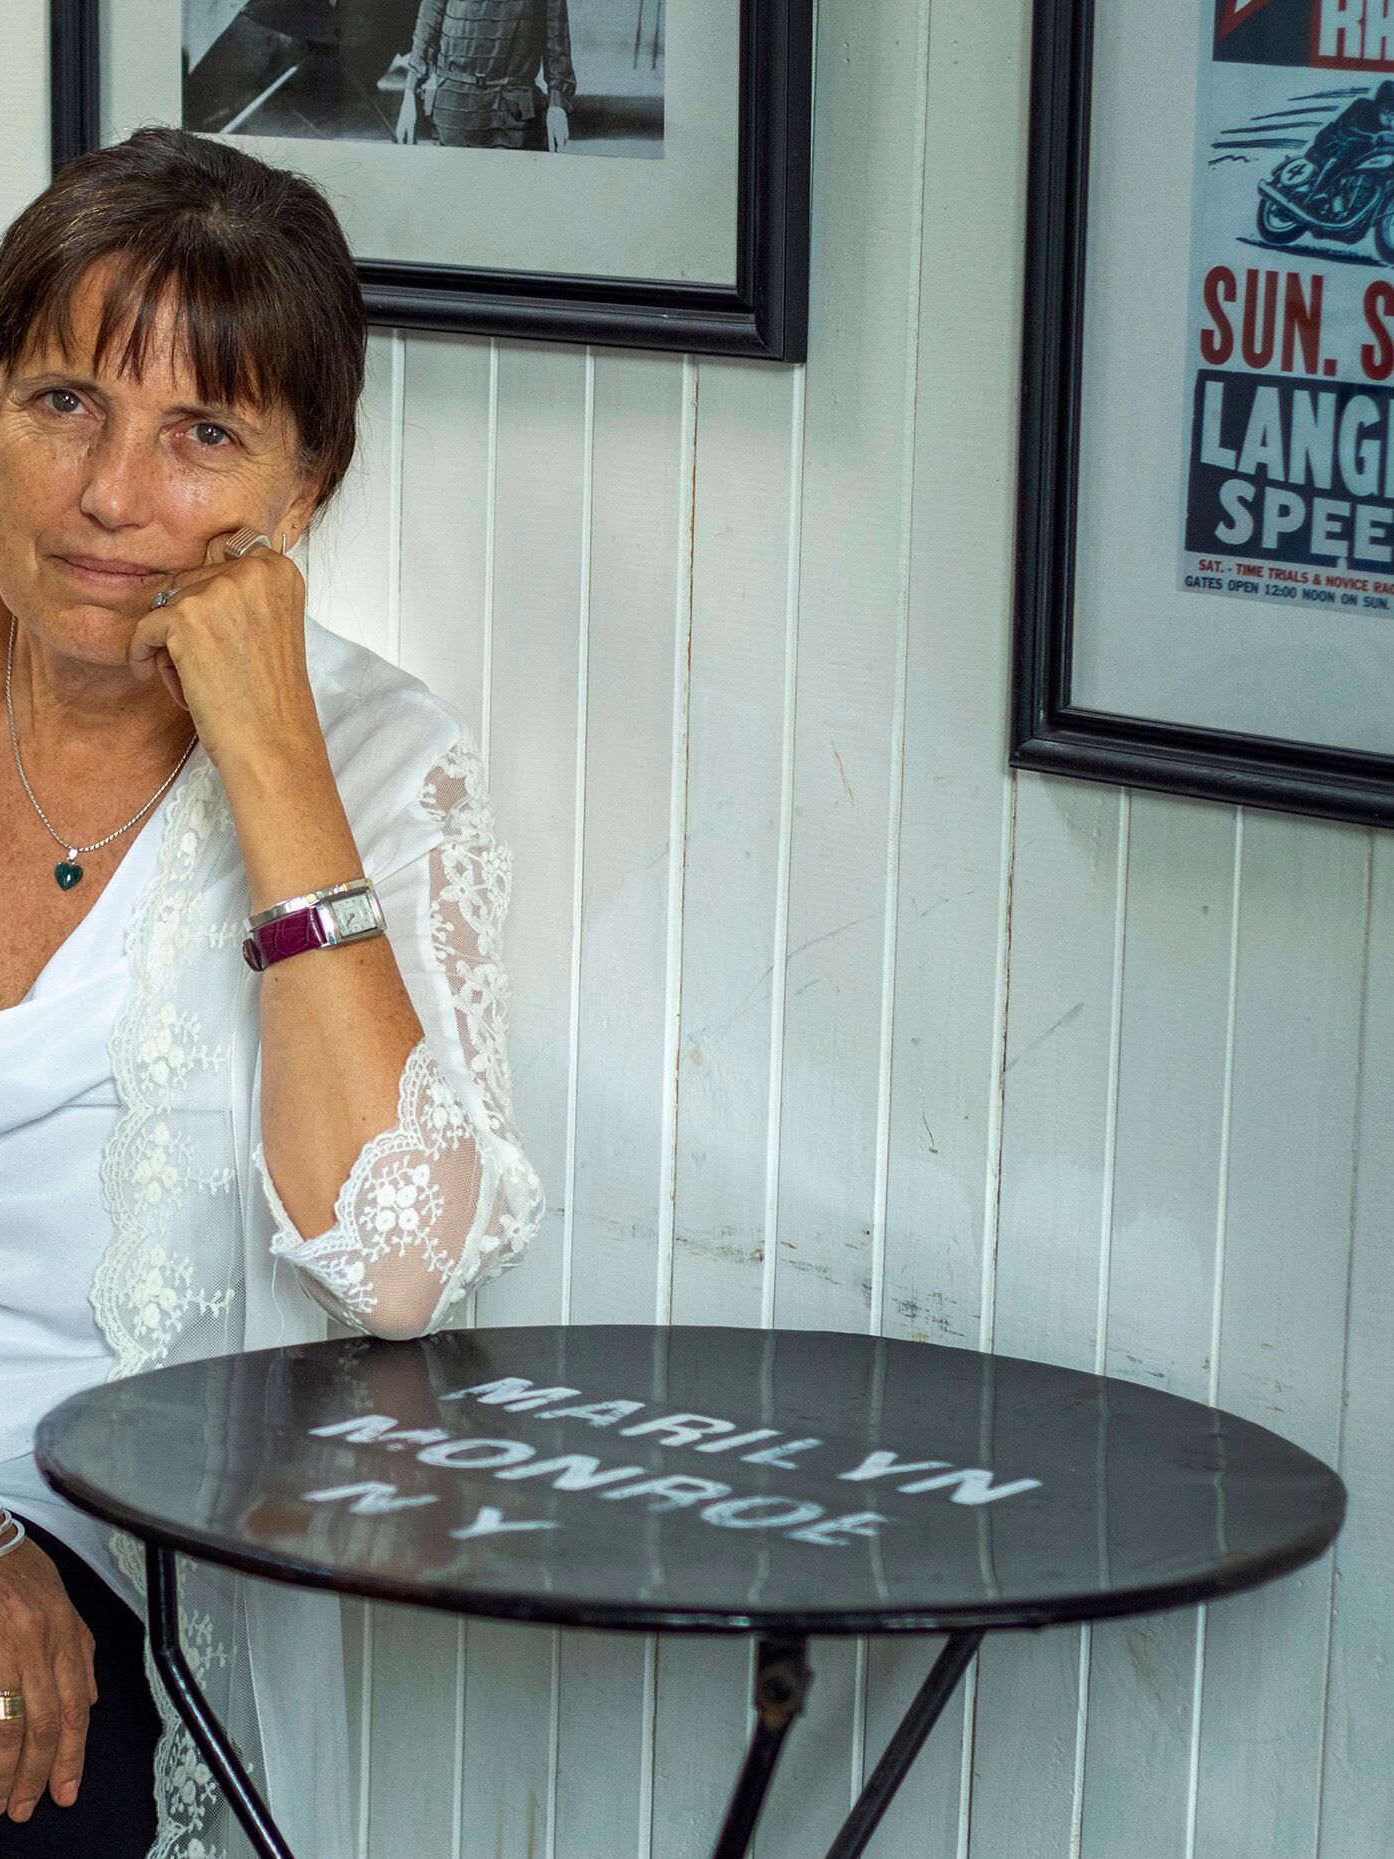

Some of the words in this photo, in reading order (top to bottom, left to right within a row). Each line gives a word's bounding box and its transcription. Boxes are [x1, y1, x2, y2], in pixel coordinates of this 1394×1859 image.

[1200, 265, 1338, 377] SUN.
[1200, 380, 1394, 499] LANG
[1185, 575, 1223, 590] GATES
[1228, 579, 1259, 594] OPEN
[1265, 584, 1297, 599] 12:00
[1302, 588, 1335, 603] NOON
[1341, 592, 1358, 606] ON
[1199, 559, 1224, 573] SAT.
[1236, 563, 1263, 578] TIME
[1268, 567, 1309, 584] TRIALS
[1312, 573, 1322, 585] &
[1326, 575, 1369, 592] NOVICE
[308, 1414, 890, 1546] MONROE
[438, 1376, 1043, 1505] MARILYN
